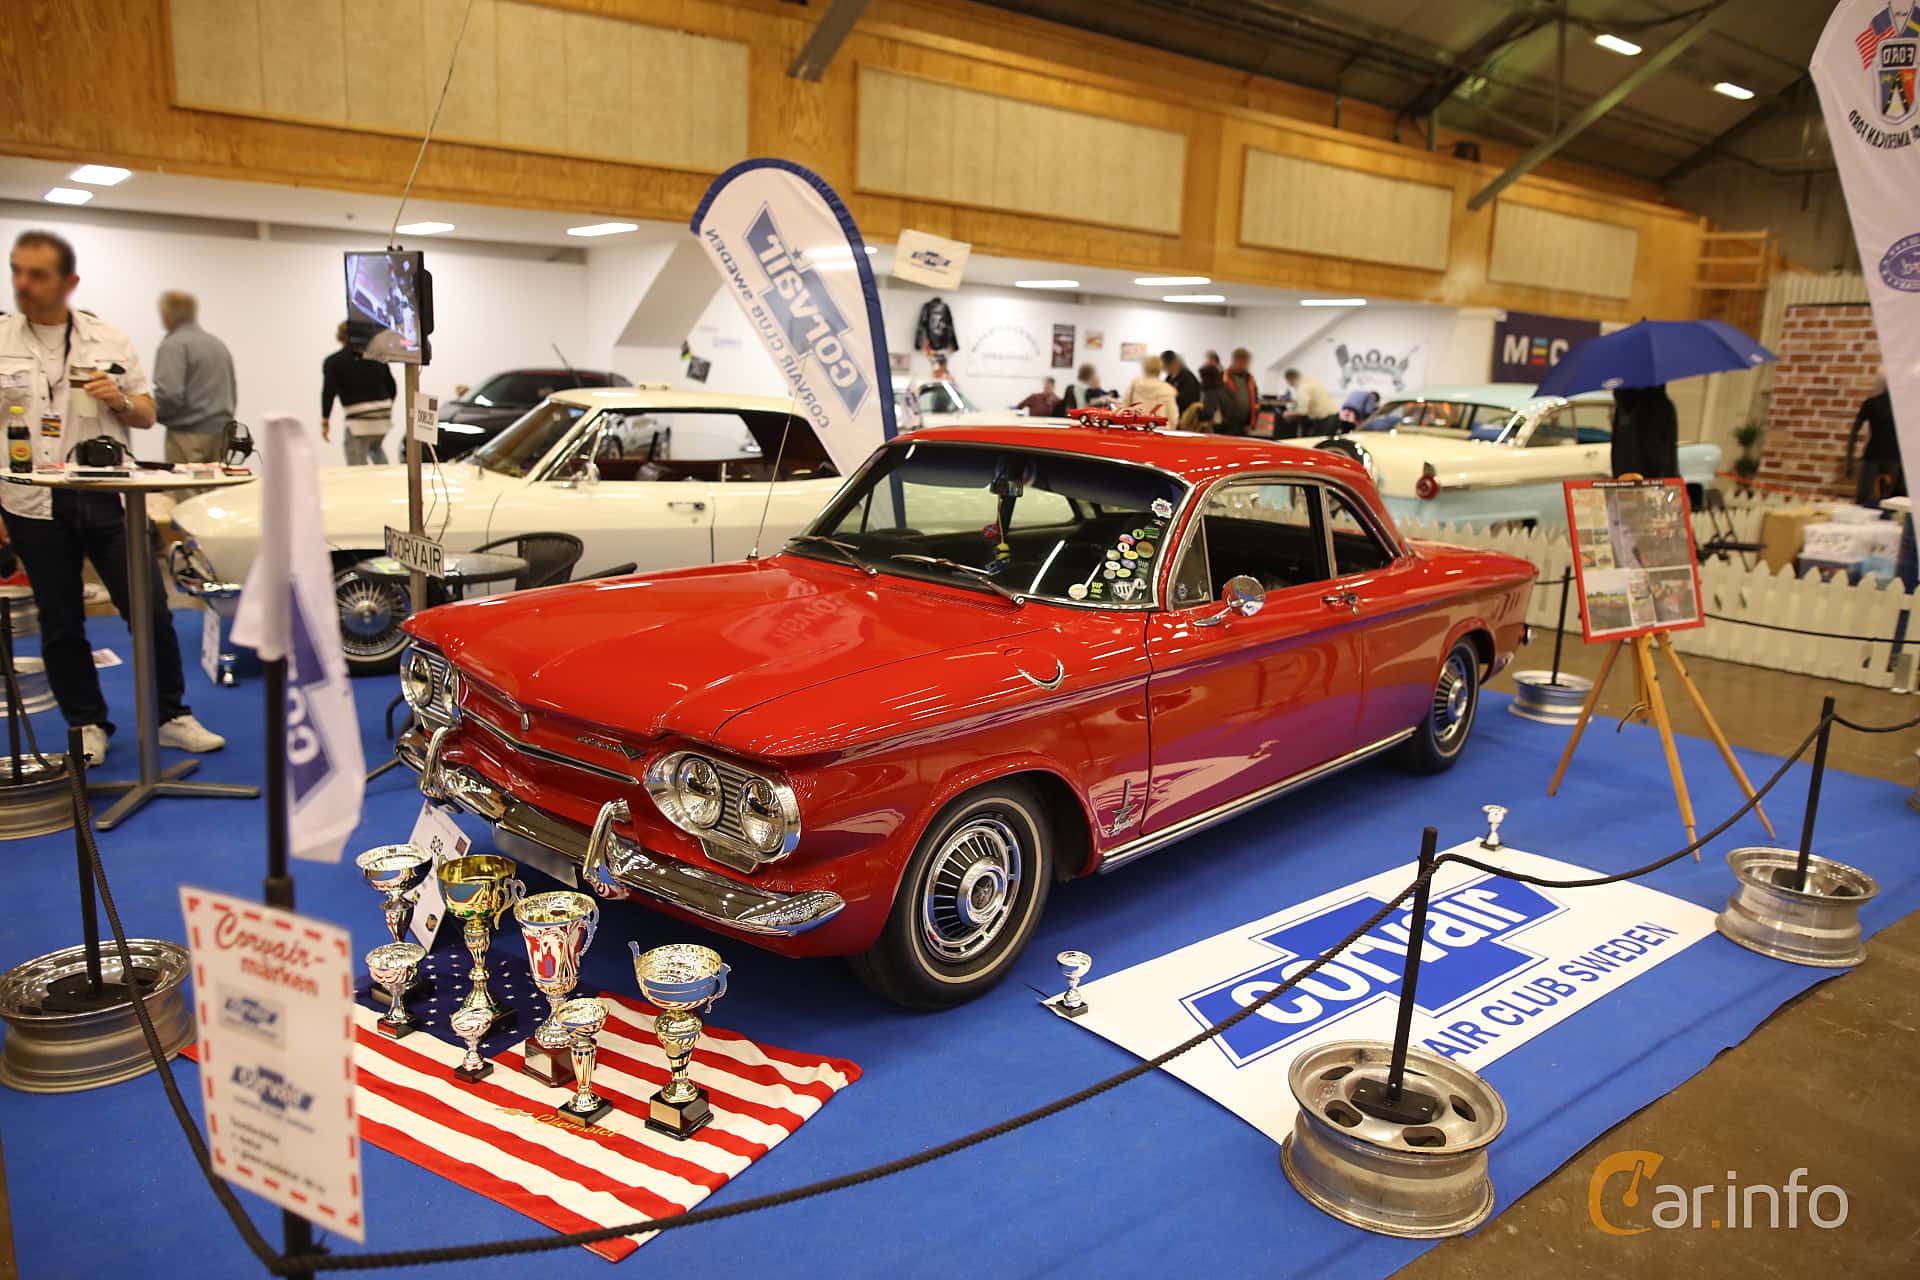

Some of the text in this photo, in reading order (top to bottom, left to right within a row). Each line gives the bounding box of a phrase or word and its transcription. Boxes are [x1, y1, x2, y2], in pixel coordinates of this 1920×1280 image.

[392, 533, 442, 575] CORVAIR
[1231, 887, 1528, 1024] corvair
[1421, 921, 1680, 1062] AIR CLUB SWEDEN
